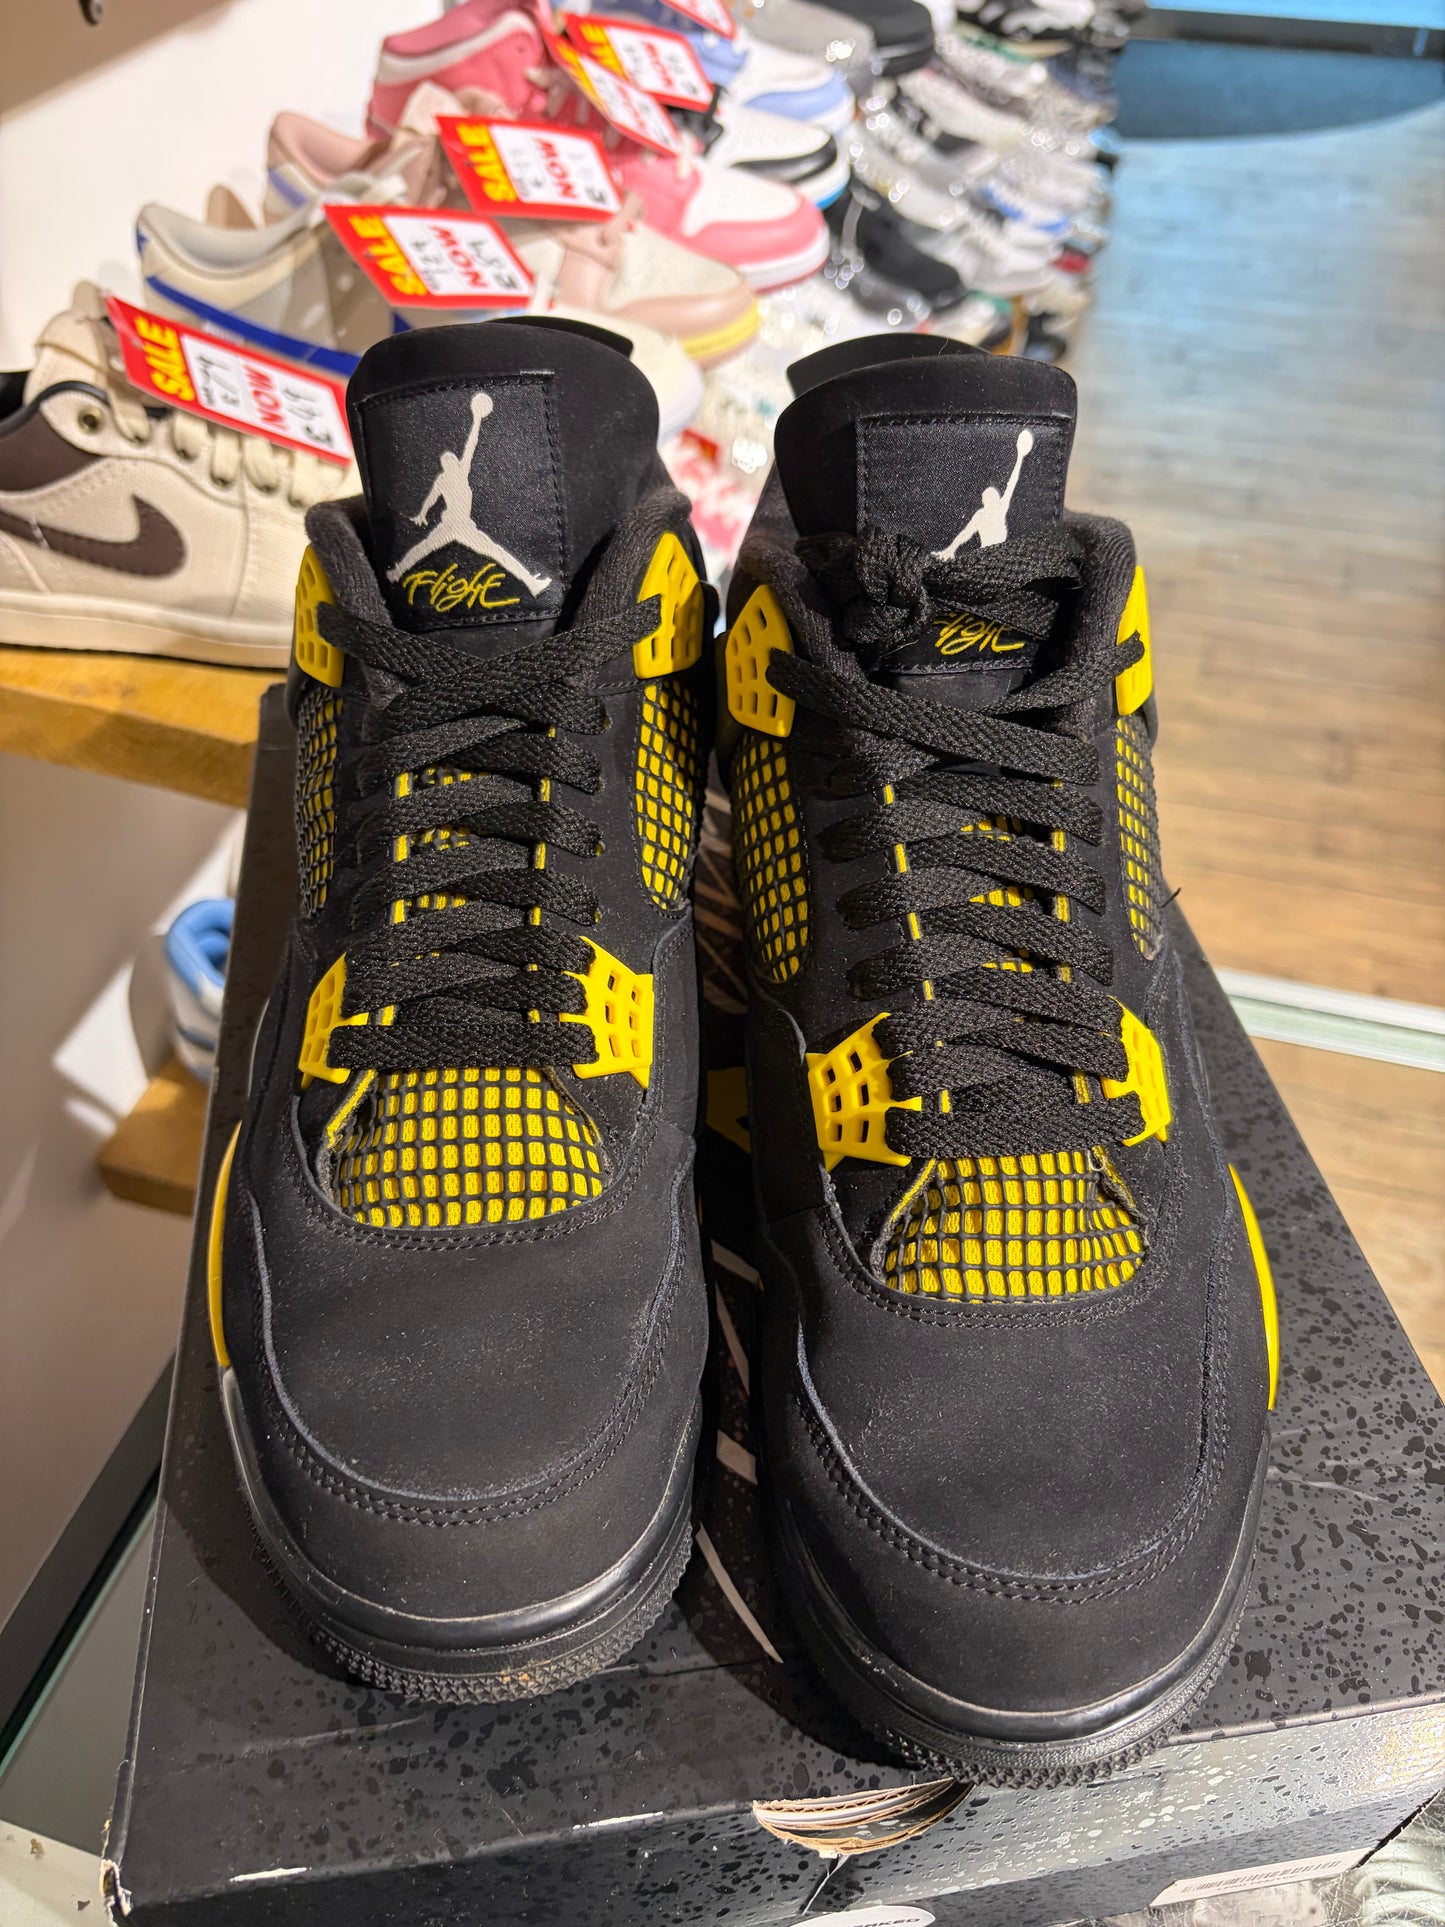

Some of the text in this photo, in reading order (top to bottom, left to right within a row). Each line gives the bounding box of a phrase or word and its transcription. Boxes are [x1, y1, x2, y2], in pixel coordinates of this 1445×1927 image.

[456, 124, 518, 202] SALE
[535, 137, 579, 200] NOW
[349, 215, 428, 296] SALE
[430, 226, 488, 288] NOW
[134, 316, 195, 402] SALE
[243, 364, 288, 432] NOW
[402, 563, 520, 612] Flight
